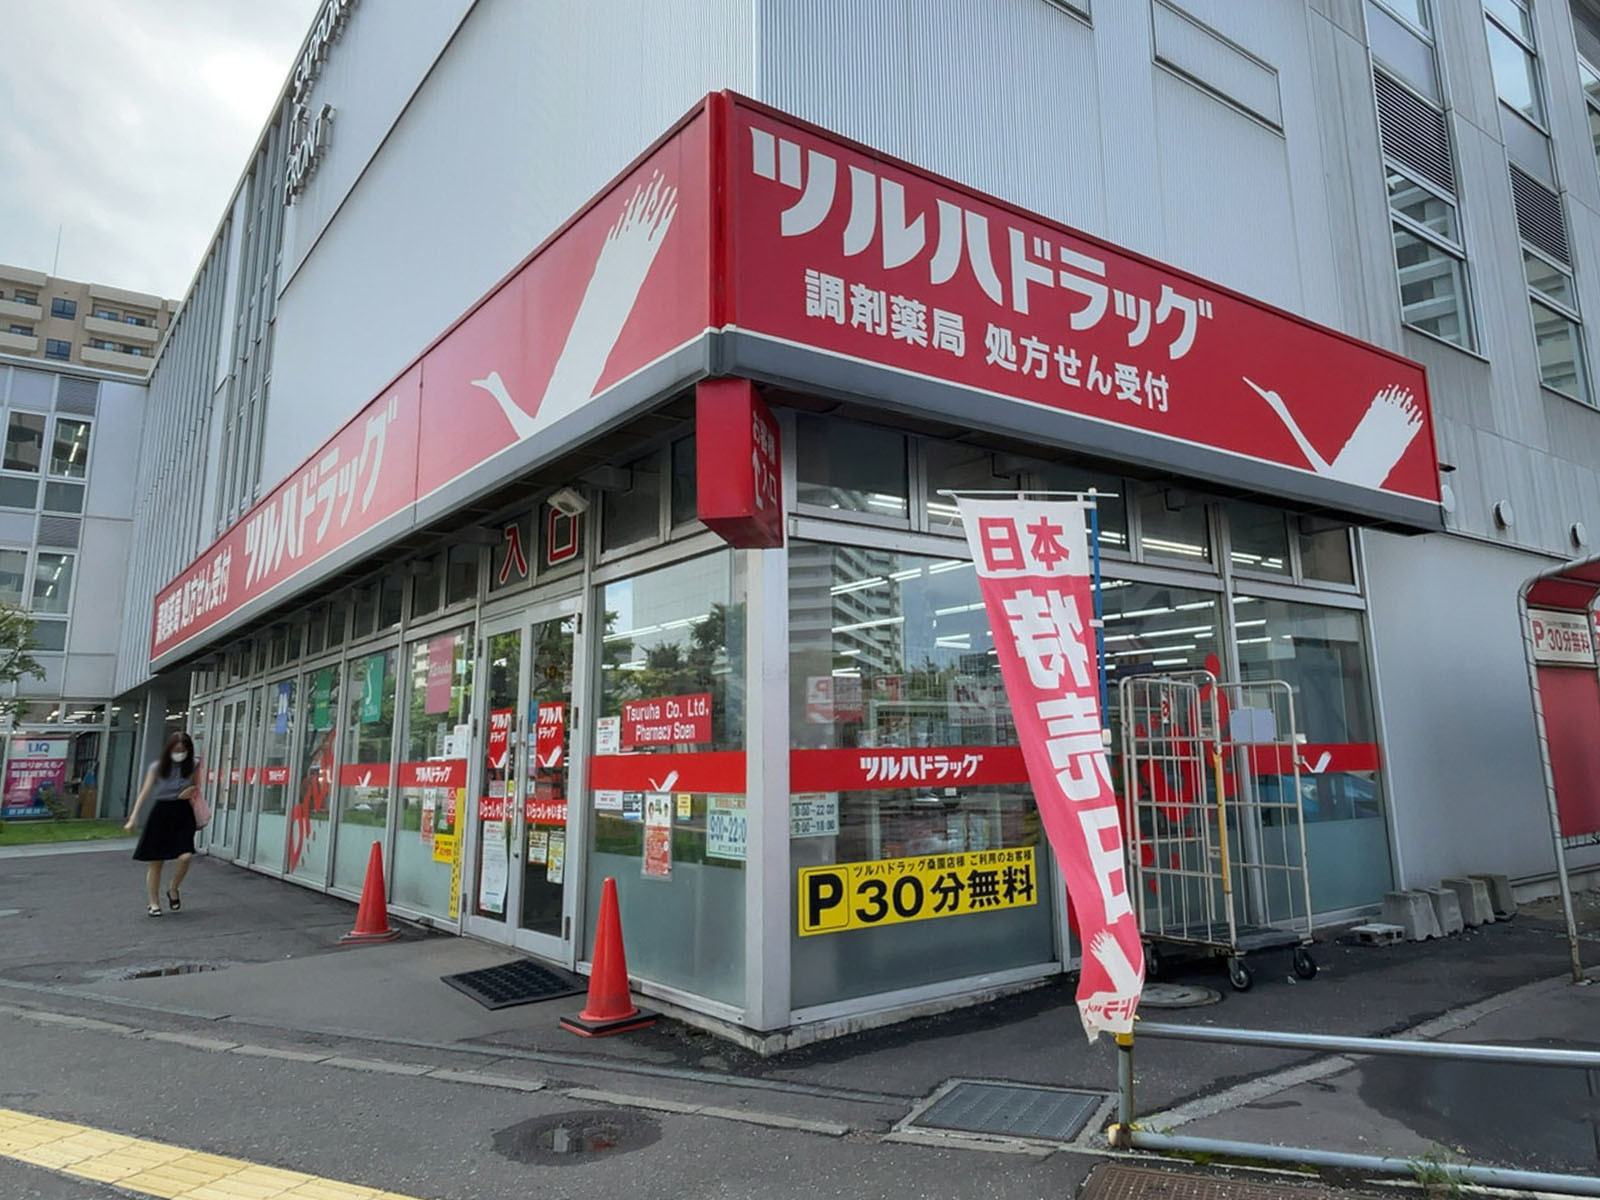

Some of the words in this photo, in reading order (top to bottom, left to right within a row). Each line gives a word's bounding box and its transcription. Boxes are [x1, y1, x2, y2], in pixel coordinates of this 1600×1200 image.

[749, 126, 1214, 361] ツルハドラッグ
[804, 268, 966, 358] 調剤薬局
[984, 323, 1169, 413] 処方せん受付
[244, 395, 398, 592] ツルハドラッグ
[500, 508, 579, 568] 入口
[1532, 620, 1545, 649] P
[539, 706, 563, 725] ツルハ
[626, 703, 660, 722] Tsuruha
[666, 701, 683, 719] Co.
[635, 723, 672, 741] Pharmacy
[28, 742, 50, 753] UQ
[859, 754, 984, 781] ツルハドラッグ
[808, 873, 843, 927] P
[855, 865, 1034, 923] 30分無料
